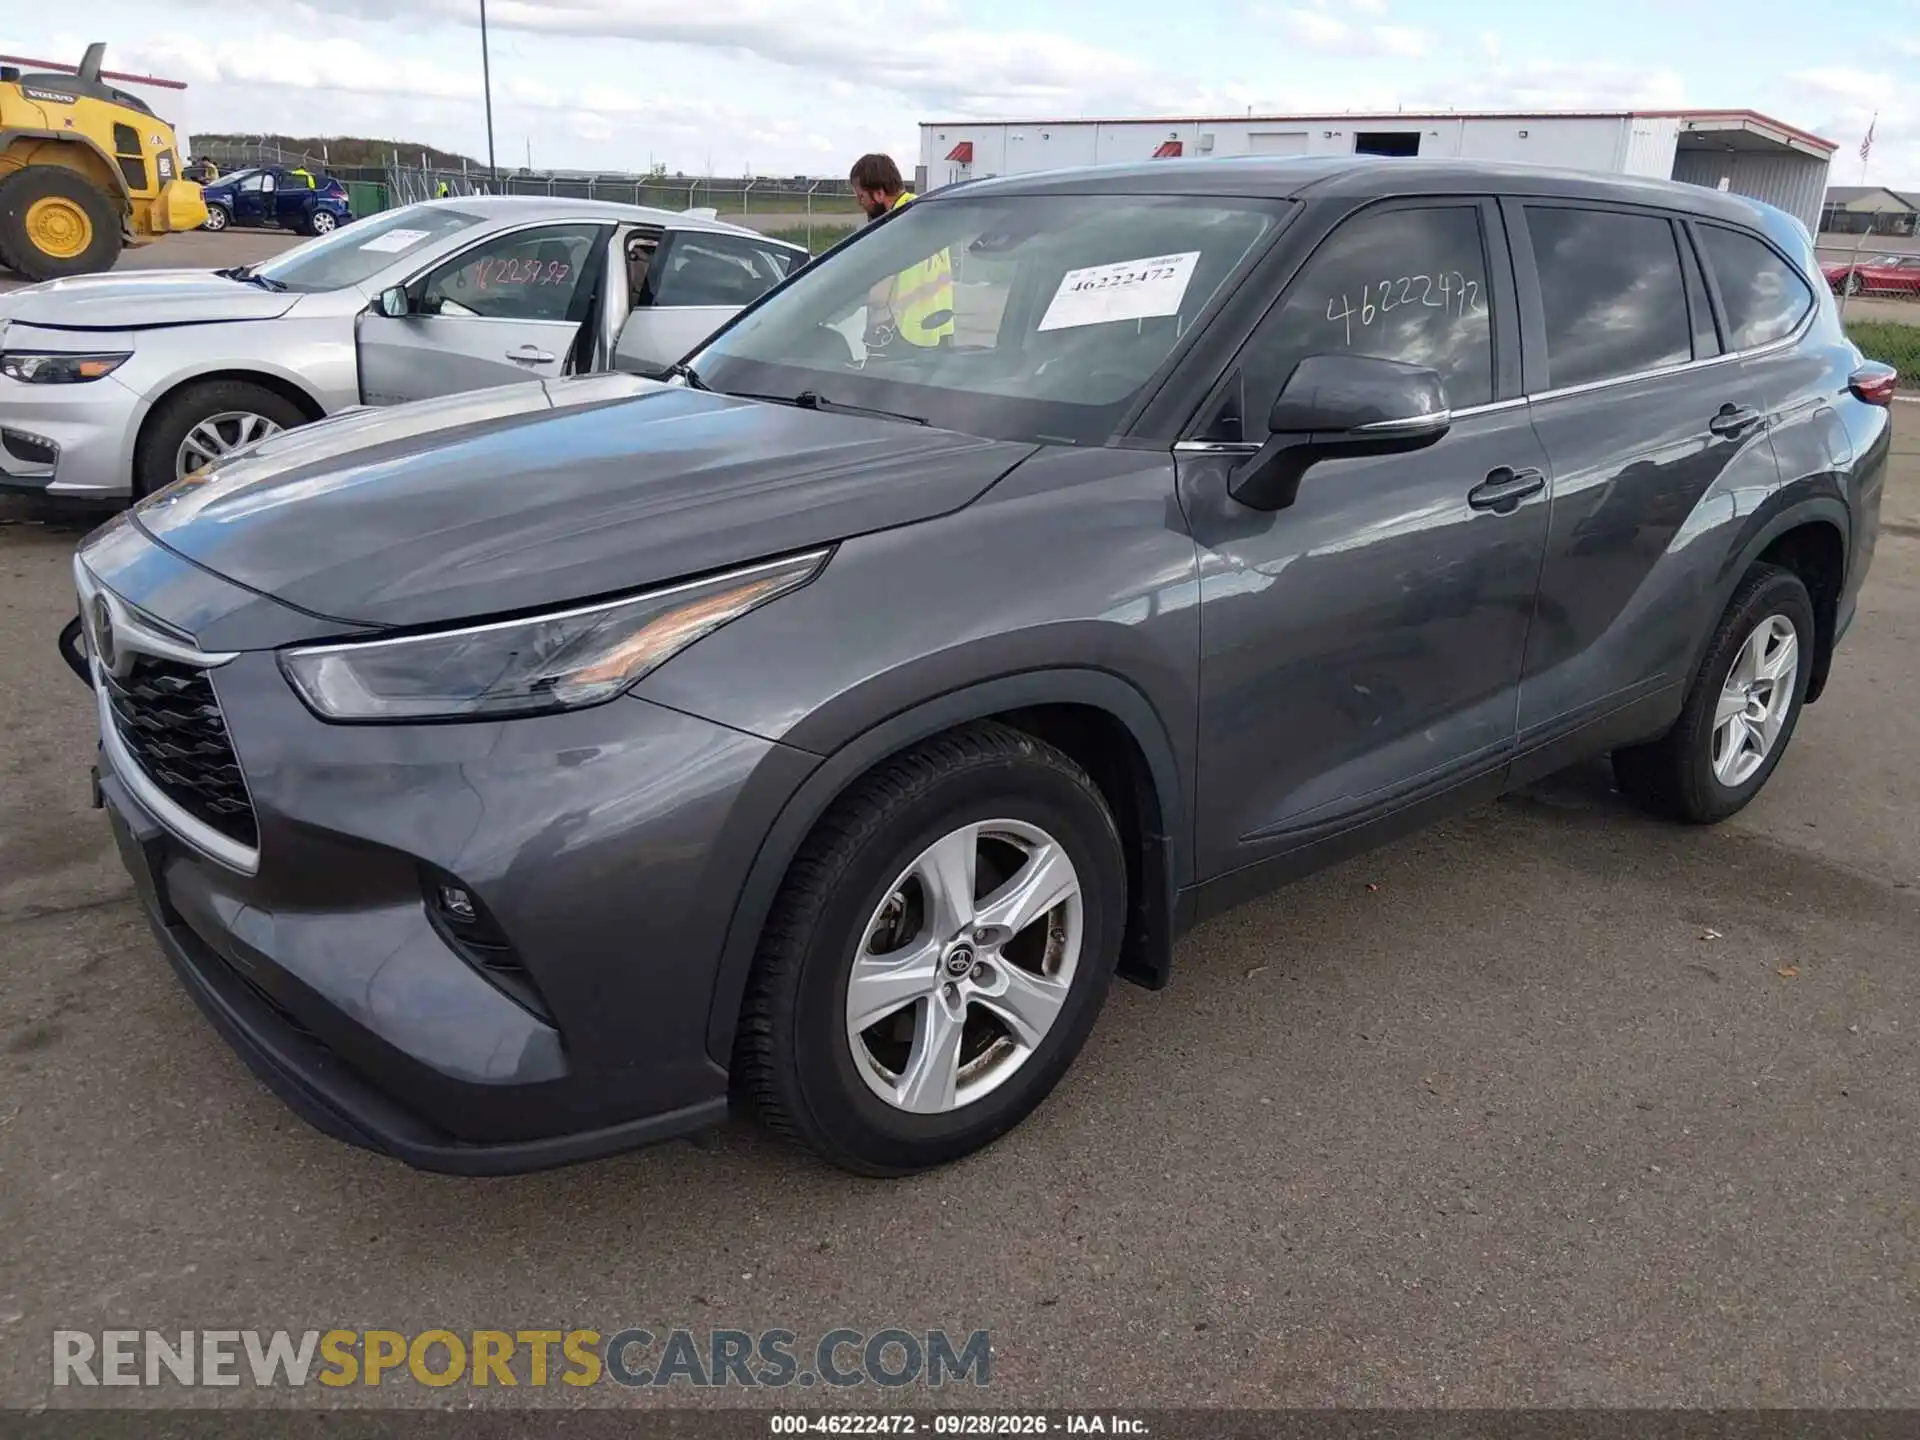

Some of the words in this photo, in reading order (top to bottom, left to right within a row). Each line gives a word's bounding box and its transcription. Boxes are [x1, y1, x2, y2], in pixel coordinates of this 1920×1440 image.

[27, 89, 74, 103] VOLVO
[1071, 267, 1175, 292] 46222472
[1326, 271, 1489, 345] 46222472
